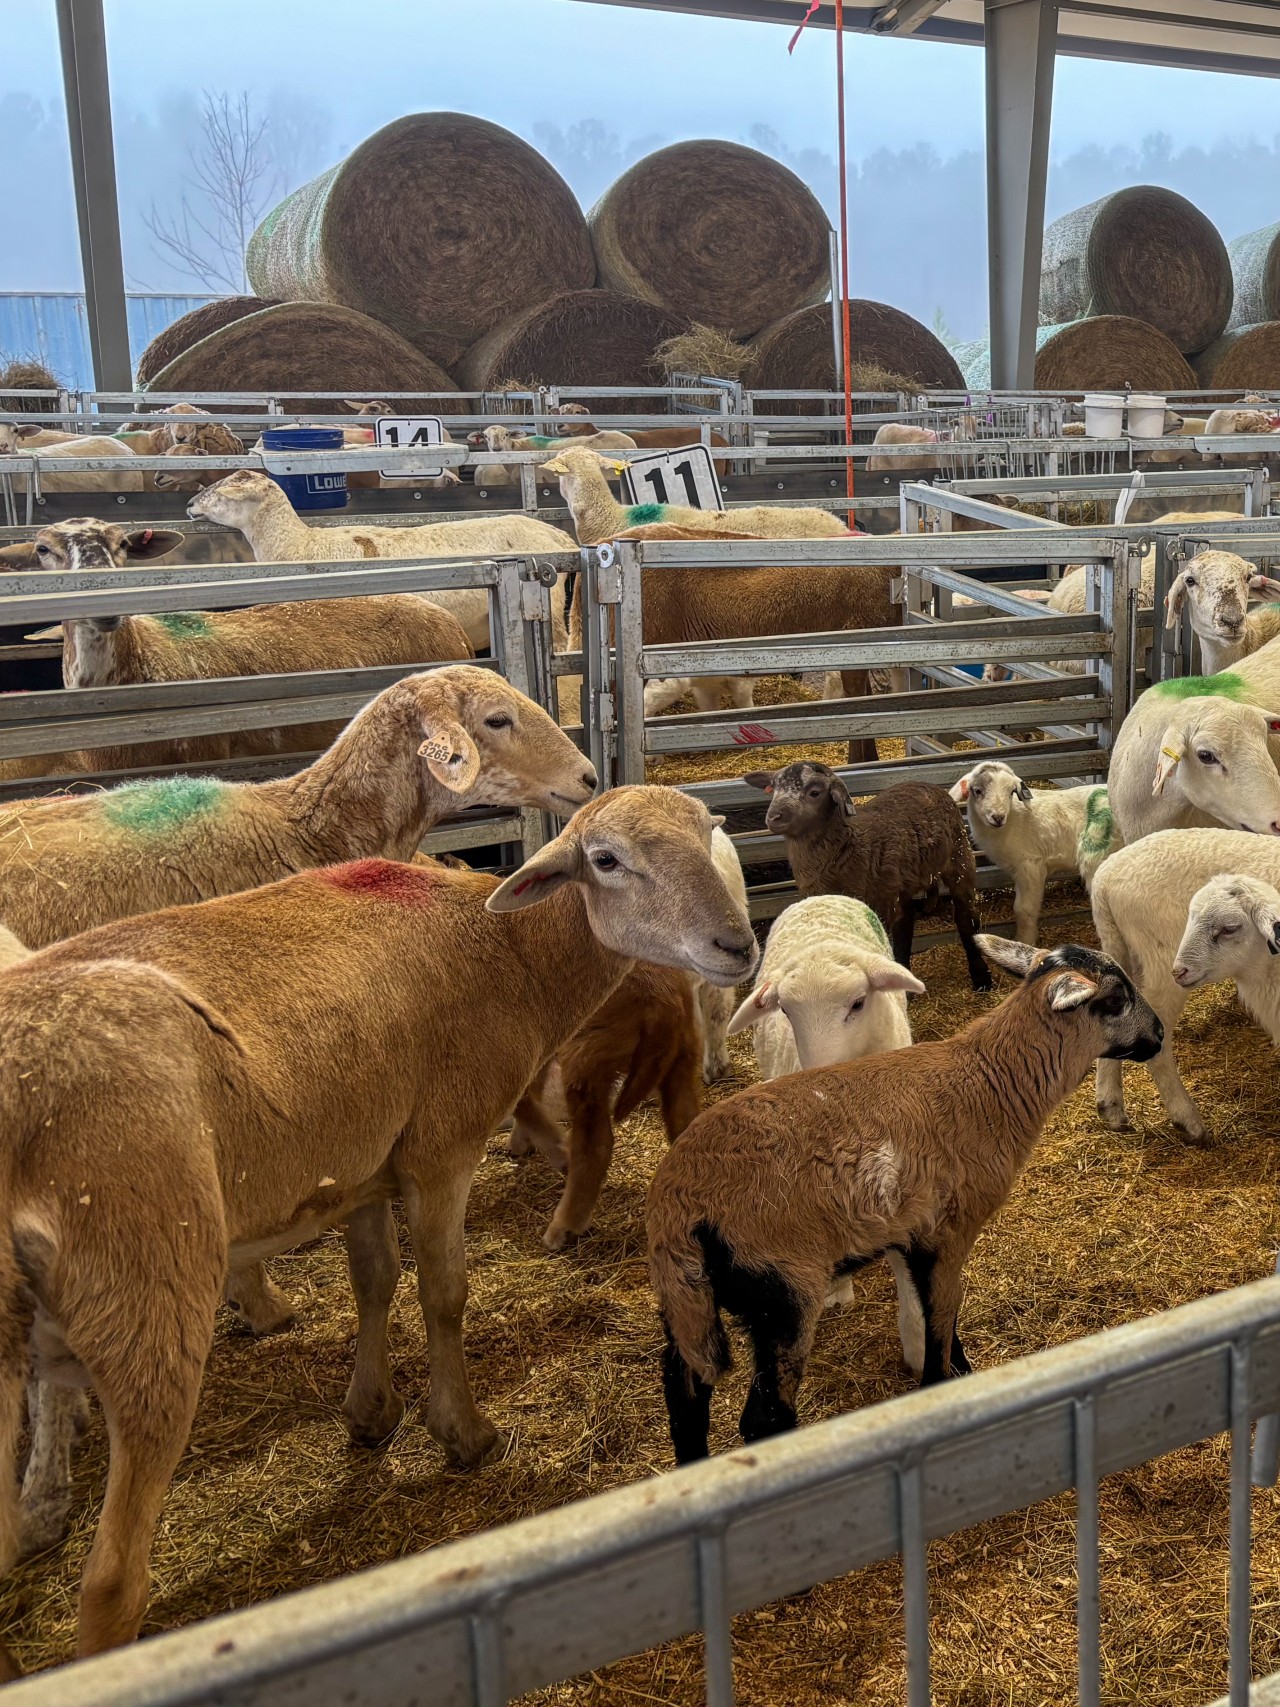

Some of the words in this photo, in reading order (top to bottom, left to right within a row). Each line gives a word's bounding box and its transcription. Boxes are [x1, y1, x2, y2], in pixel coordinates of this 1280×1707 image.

[385, 426, 429, 448] 14
[644, 460, 702, 510] 11
[419, 744, 450, 762] 3265
